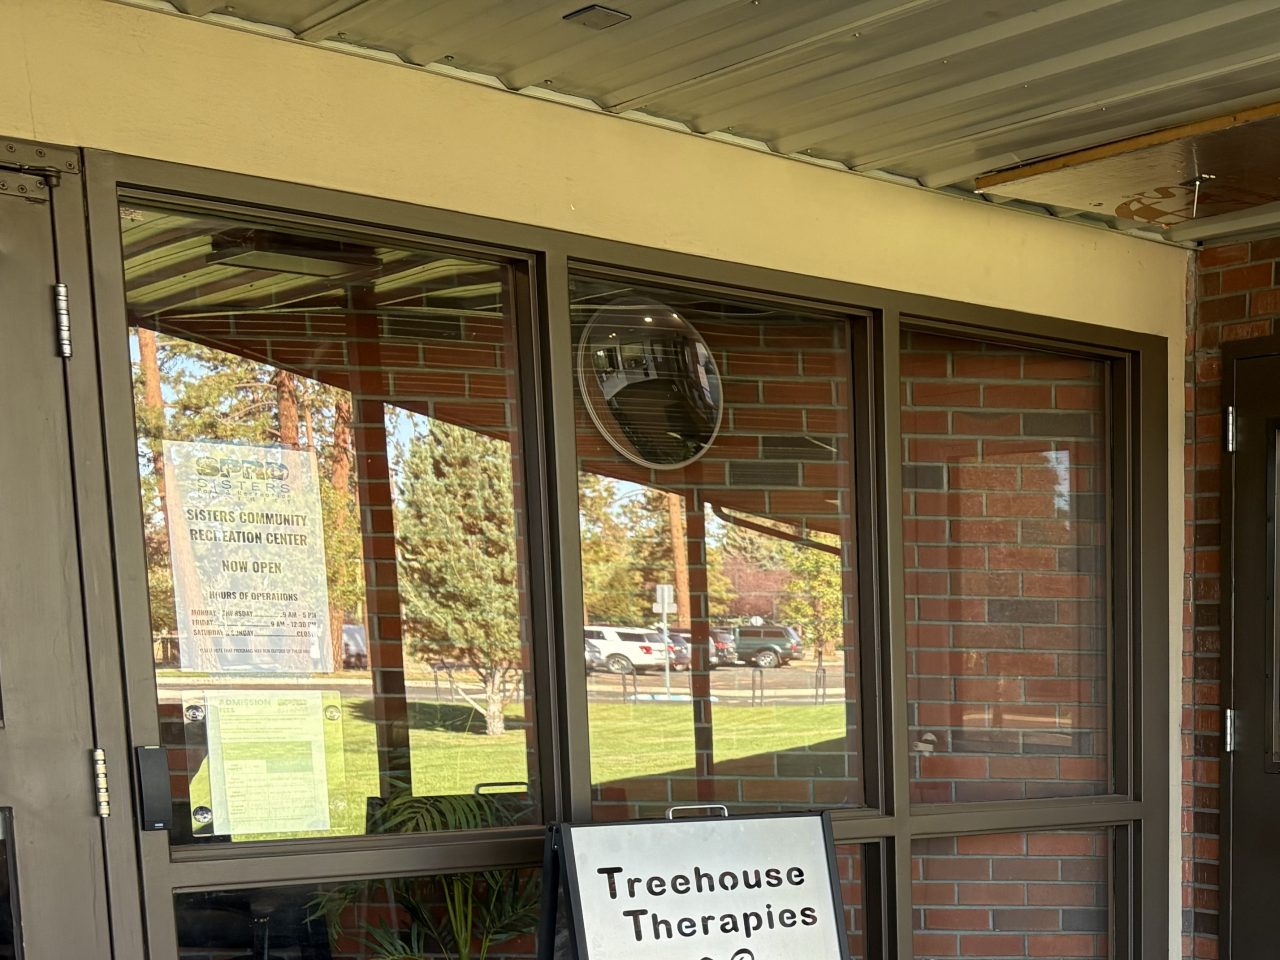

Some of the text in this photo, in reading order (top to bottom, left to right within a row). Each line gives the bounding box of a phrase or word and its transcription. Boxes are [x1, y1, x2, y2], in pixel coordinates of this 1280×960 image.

[197, 478, 290, 493] SISTERS
[187, 509, 307, 526] SISTERS COMMUNITY
[266, 532, 307, 546] CENTER
[222, 560, 281, 574] NOW OPEN
[209, 591, 298, 602] HOURS OF OPERATIONS
[597, 865, 806, 899] Treehouse
[622, 903, 818, 942] Therapies
